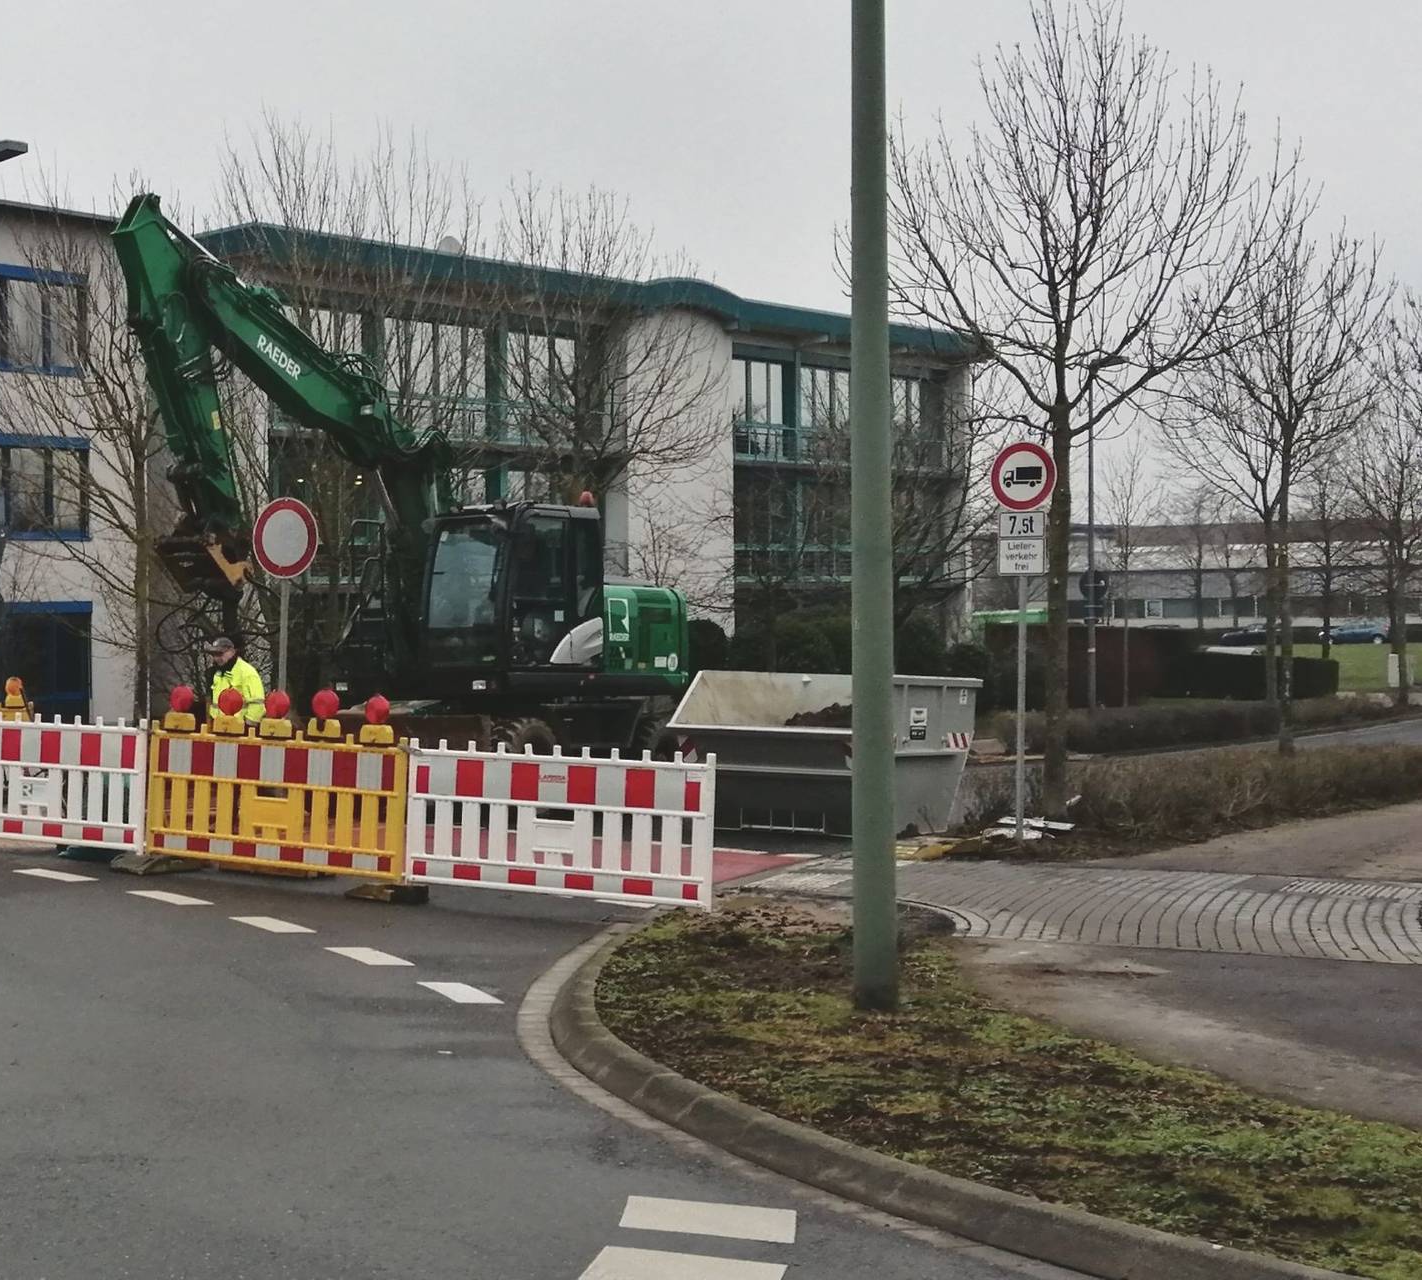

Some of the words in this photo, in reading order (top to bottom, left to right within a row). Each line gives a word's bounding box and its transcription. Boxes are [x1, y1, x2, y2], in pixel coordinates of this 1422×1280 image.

[257, 334, 301, 381] RAEDER
[1008, 542, 1036, 551] Liefer-
[1005, 552, 1038, 561] verkehr
[1014, 562, 1029, 571] frei
